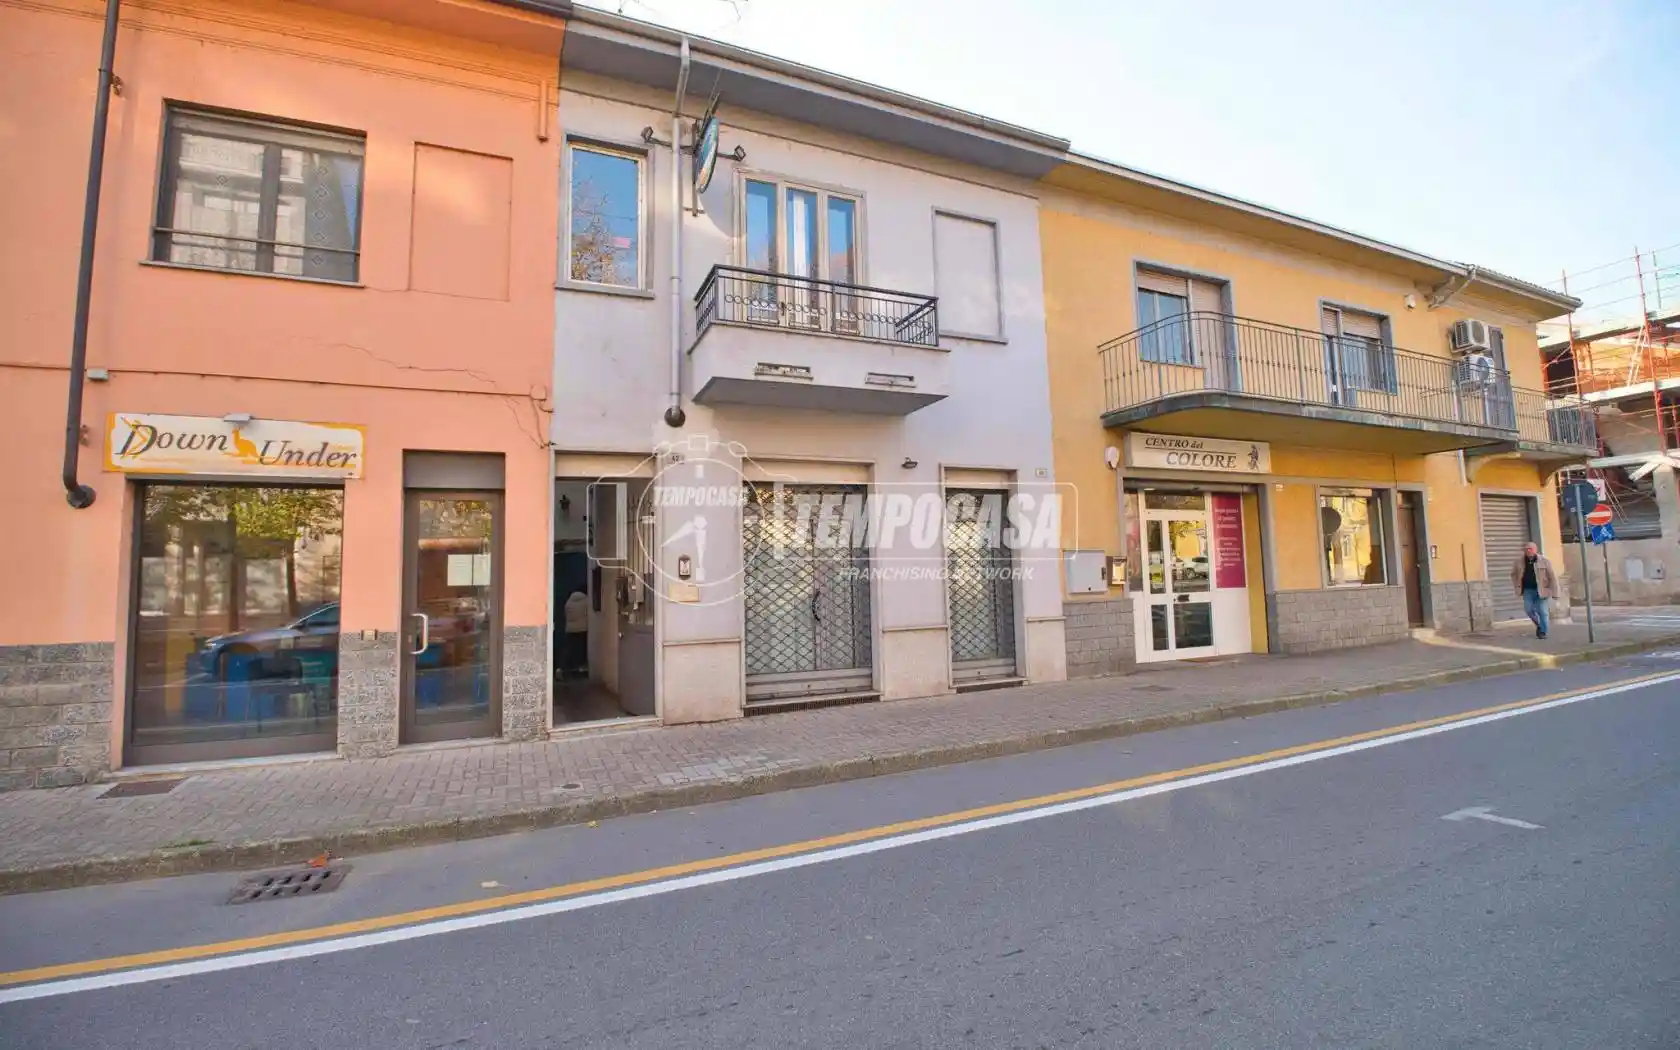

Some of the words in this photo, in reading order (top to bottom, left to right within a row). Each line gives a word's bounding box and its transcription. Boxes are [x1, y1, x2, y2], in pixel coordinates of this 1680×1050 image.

[113, 424, 228, 456] Down
[259, 440, 357, 468] Under
[1145, 437, 1189, 448] CENTRO
[1190, 441, 1203, 449] del
[1166, 451, 1237, 469] COLORE
